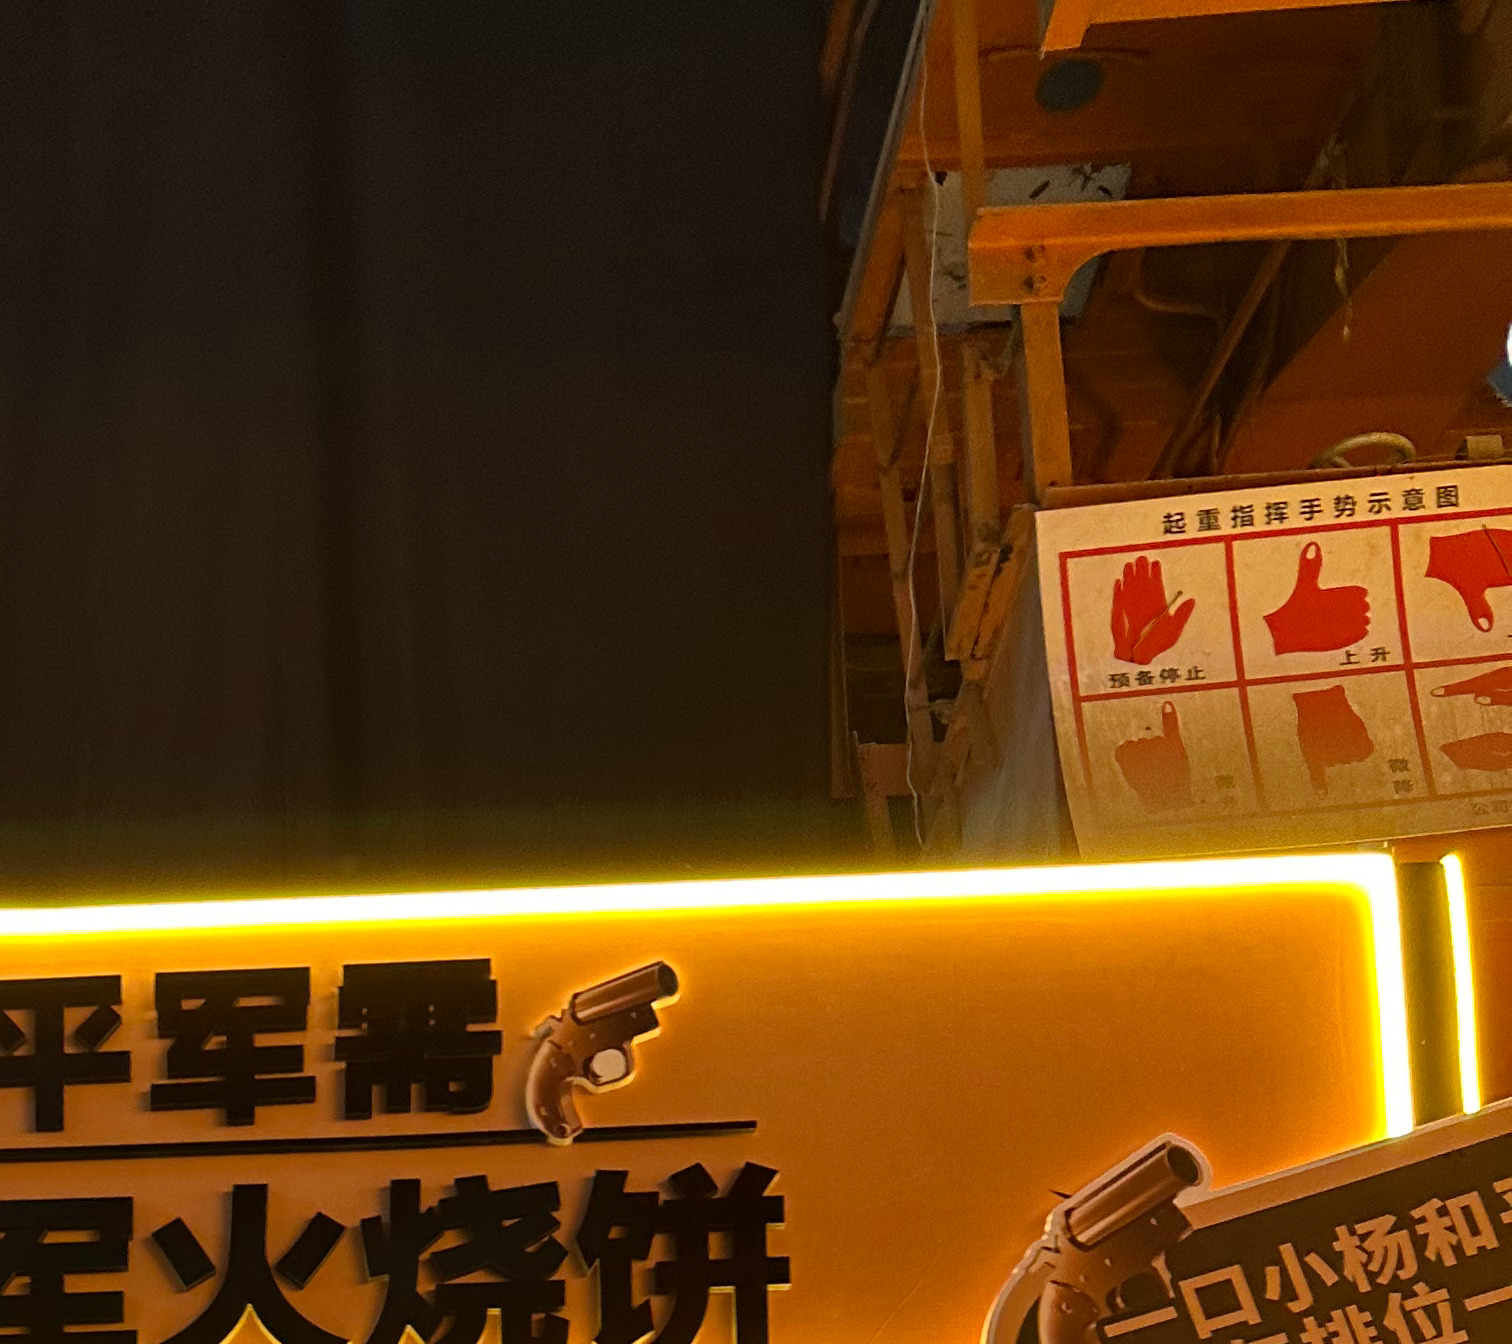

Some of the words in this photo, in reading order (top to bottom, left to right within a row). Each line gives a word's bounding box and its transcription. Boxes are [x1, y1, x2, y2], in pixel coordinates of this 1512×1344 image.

[1161, 485, 1462, 536] 起重指挥手势示意图
[1339, 645, 1392, 667] 上升
[1107, 665, 1207, 690] 预备停止
